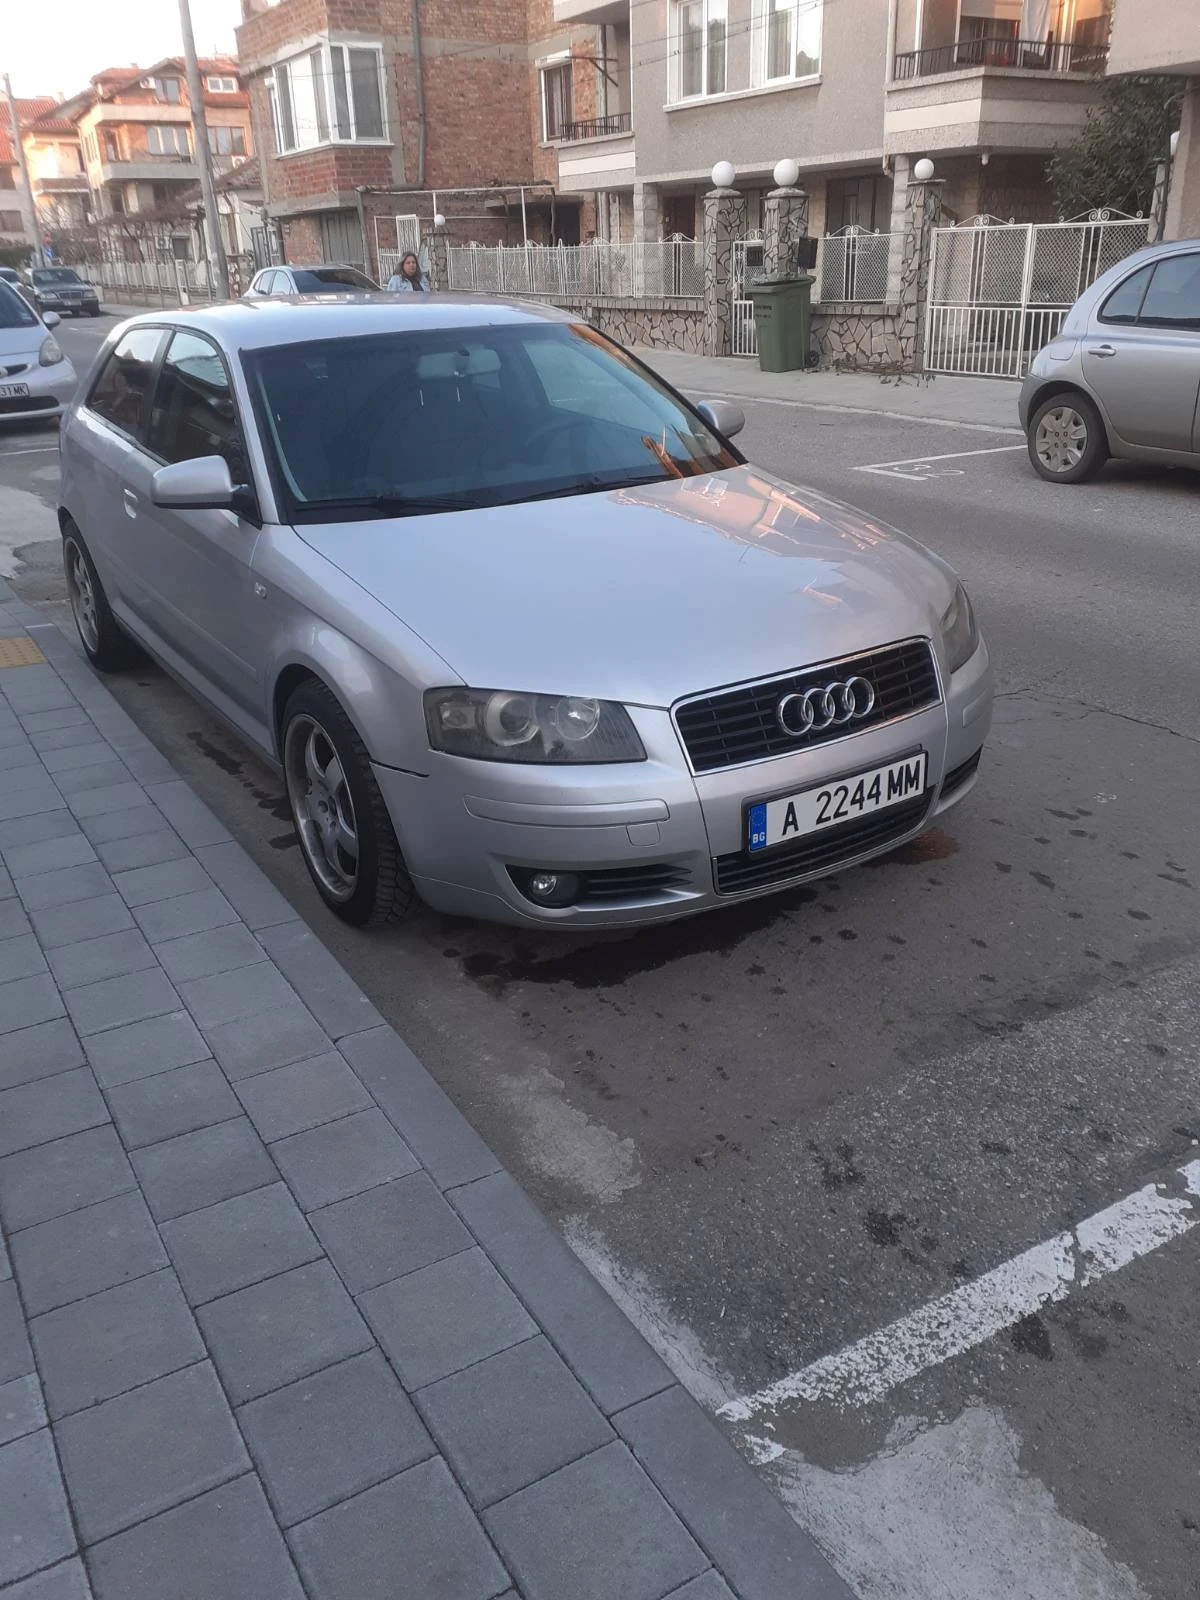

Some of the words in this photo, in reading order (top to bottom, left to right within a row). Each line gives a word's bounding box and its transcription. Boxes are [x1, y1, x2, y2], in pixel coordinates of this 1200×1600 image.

[781, 801, 799, 836] A
[816, 773, 881, 826] 2244
[887, 759, 921, 801] MM
[752, 831, 766, 844] BG
